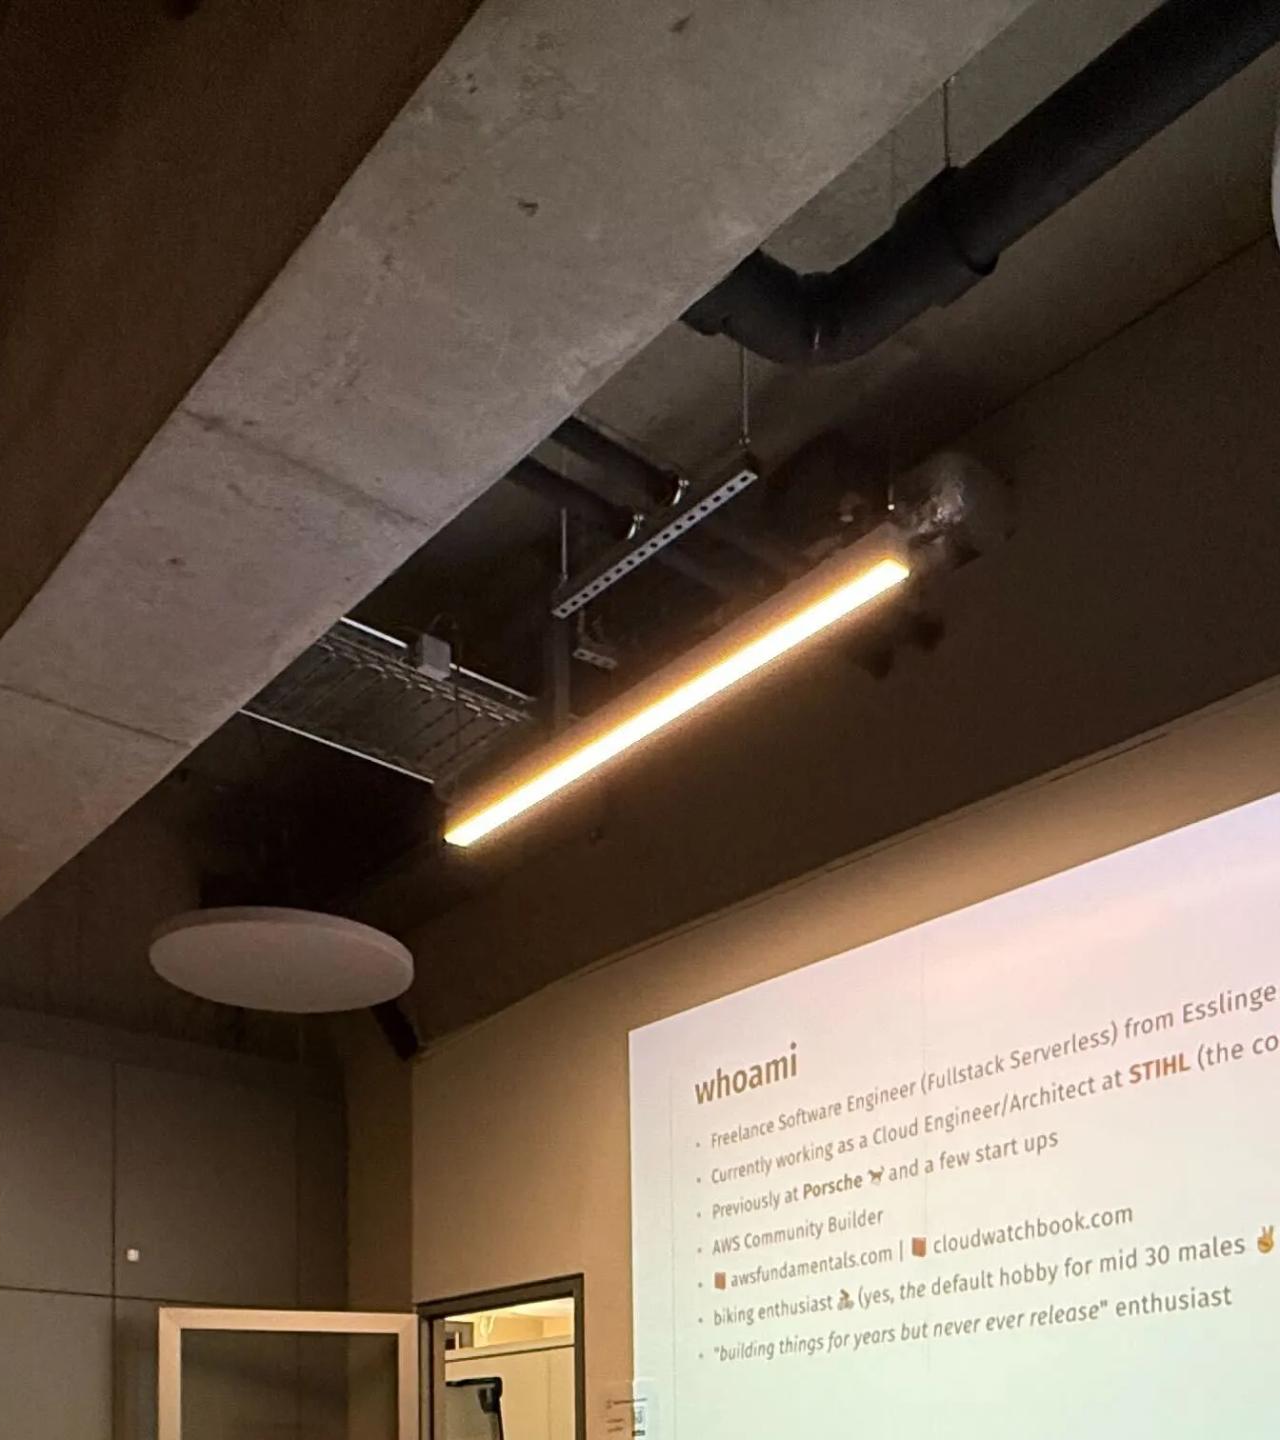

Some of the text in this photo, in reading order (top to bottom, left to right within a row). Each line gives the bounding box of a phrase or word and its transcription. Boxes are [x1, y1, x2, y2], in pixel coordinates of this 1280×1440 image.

[695, 1042, 798, 1106] whoami
[711, 1157, 772, 1184] Currently
[776, 1142, 833, 1168] working
[837, 1138, 854, 1154] as
[859, 1135, 868, 1149] a
[873, 1117, 918, 1145] Cloud
[925, 1077, 1096, 1133] Engineer/Architect
[1102, 1070, 1123, 1091] at
[1129, 1053, 1191, 1084] STIHL
[1198, 1042, 1244, 1071] (the
[712, 1121, 774, 1148] Freelance
[778, 1102, 842, 1130] Software
[847, 1082, 916, 1112] Engineer
[921, 1055, 1004, 1095] (Fullstack
[1010, 1020, 1118, 1069] Serverless)
[1124, 1012, 1174, 1038] from
[712, 1132, 1058, 1219] Previously at Porsche and a few start ups
[712, 1209, 884, 1255] AWS Community Builder
[731, 1248, 892, 1287] awsfundamentals.com
[933, 1208, 1133, 1254] cloudwatchbook.com
[714, 1308, 754, 1326] biking
[758, 1295, 833, 1320] enthusiast
[858, 1286, 894, 1310] (yes,
[900, 1282, 926, 1300] the
[931, 1270, 994, 1295] default
[1000, 1262, 1058, 1286] hobby
[1064, 1257, 1093, 1277] for
[1100, 1247, 1137, 1273] mid
[1145, 1245, 1170, 1267] 30
[1179, 1236, 1246, 1262] males
[779, 1335, 824, 1356] things
[827, 1331, 850, 1353] for
[853, 1328, 895, 1351] years
[901, 1322, 928, 1341] but
[933, 1318, 981, 1337] never
[985, 1313, 1025, 1331] ever
[1116, 1286, 1232, 1317] enthusiast
